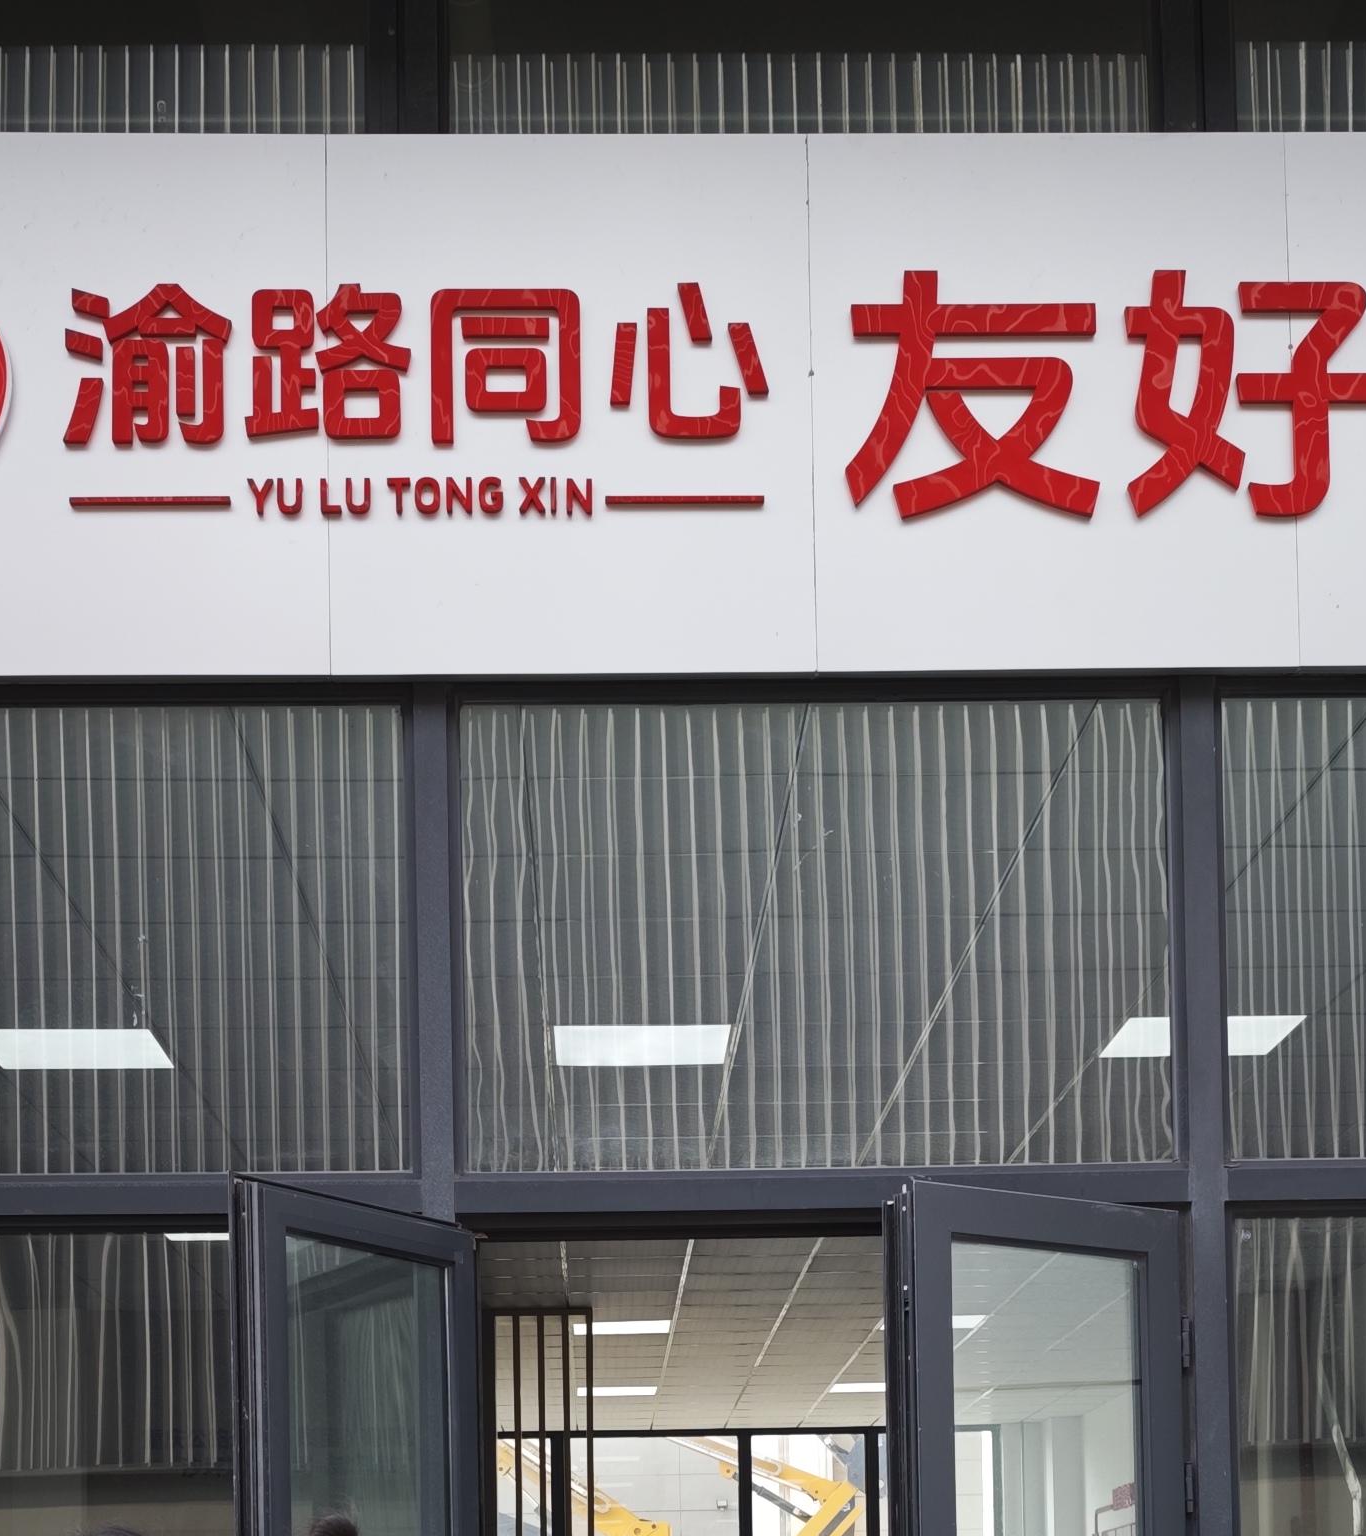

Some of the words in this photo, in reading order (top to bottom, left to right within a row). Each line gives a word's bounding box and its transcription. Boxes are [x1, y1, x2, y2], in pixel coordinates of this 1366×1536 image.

[64, 283, 768, 447] 渝路同心
[250, 479, 302, 515] YU
[321, 479, 370, 515] LU
[388, 477, 503, 515] TONG
[520, 478, 592, 516] XIN
